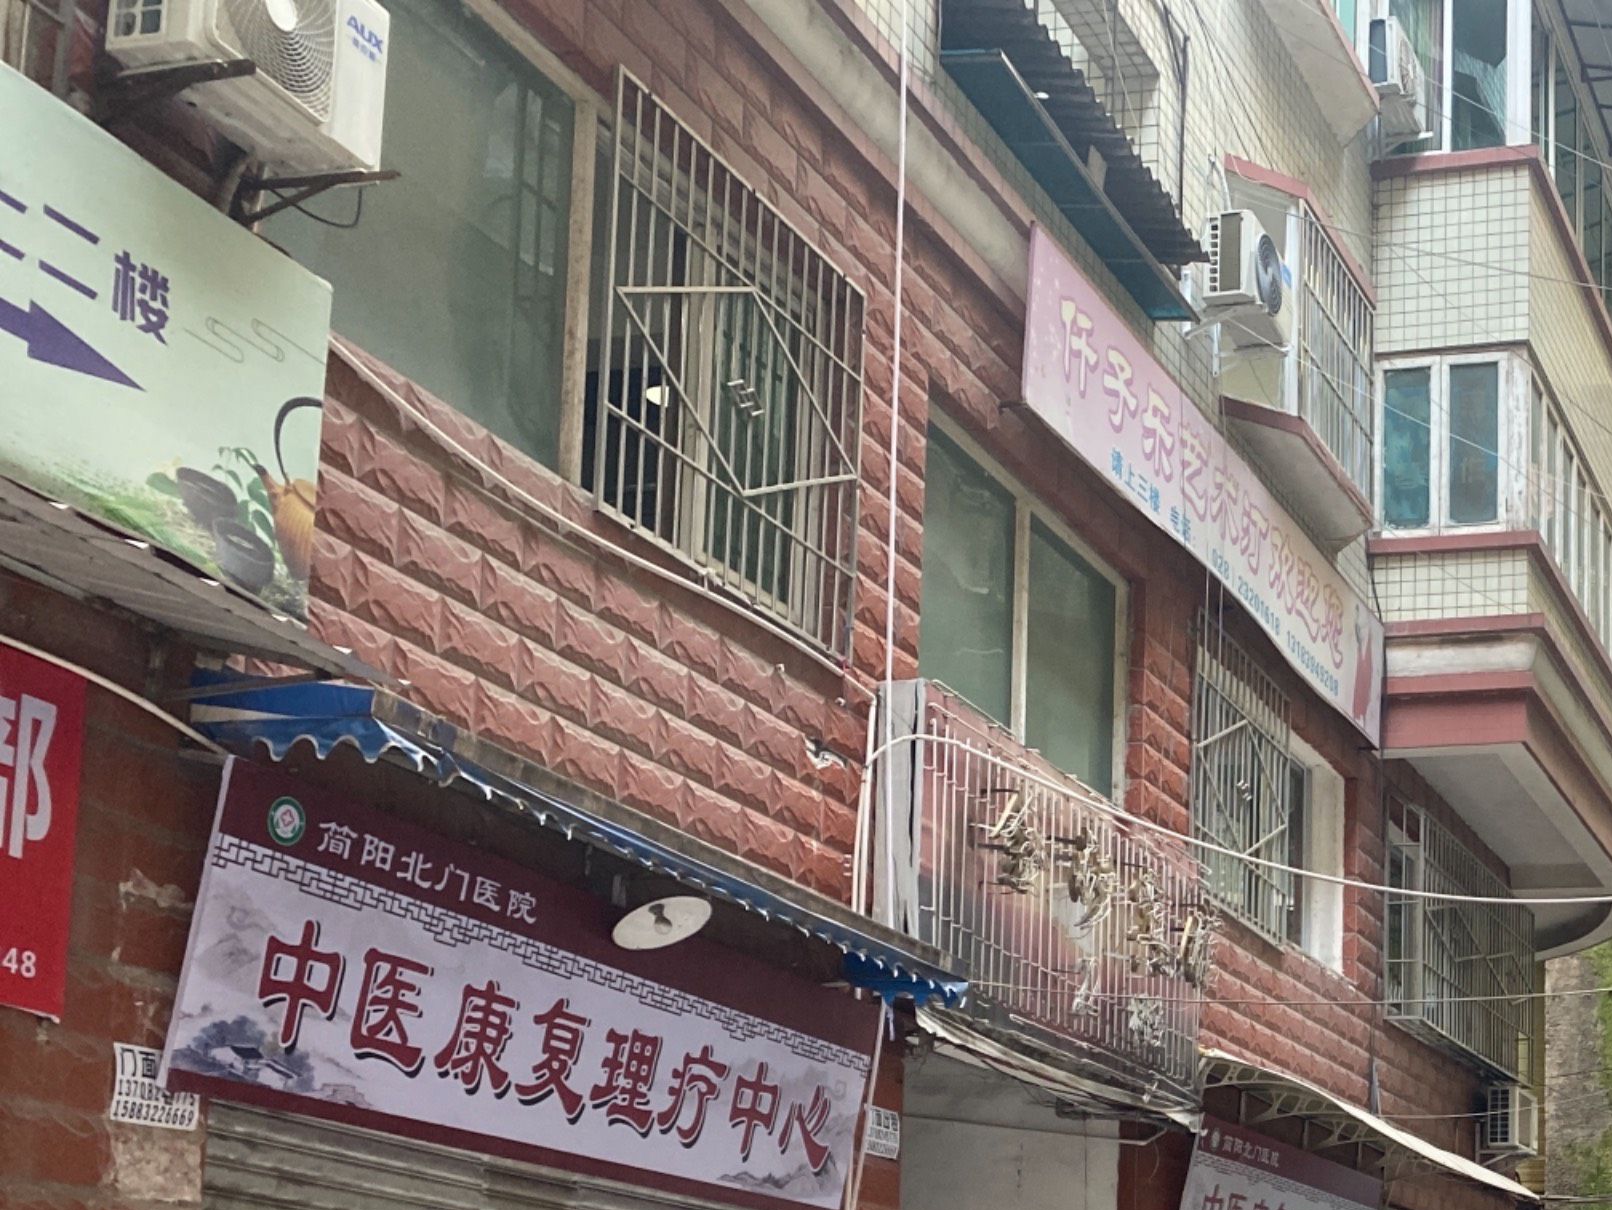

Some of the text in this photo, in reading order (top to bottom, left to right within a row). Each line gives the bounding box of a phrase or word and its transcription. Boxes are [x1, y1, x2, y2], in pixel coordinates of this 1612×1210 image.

[346, 14, 383, 54] AUX
[317, 821, 538, 924] 简阳北门医院
[258, 918, 834, 1172] 中医康复理疗中心
